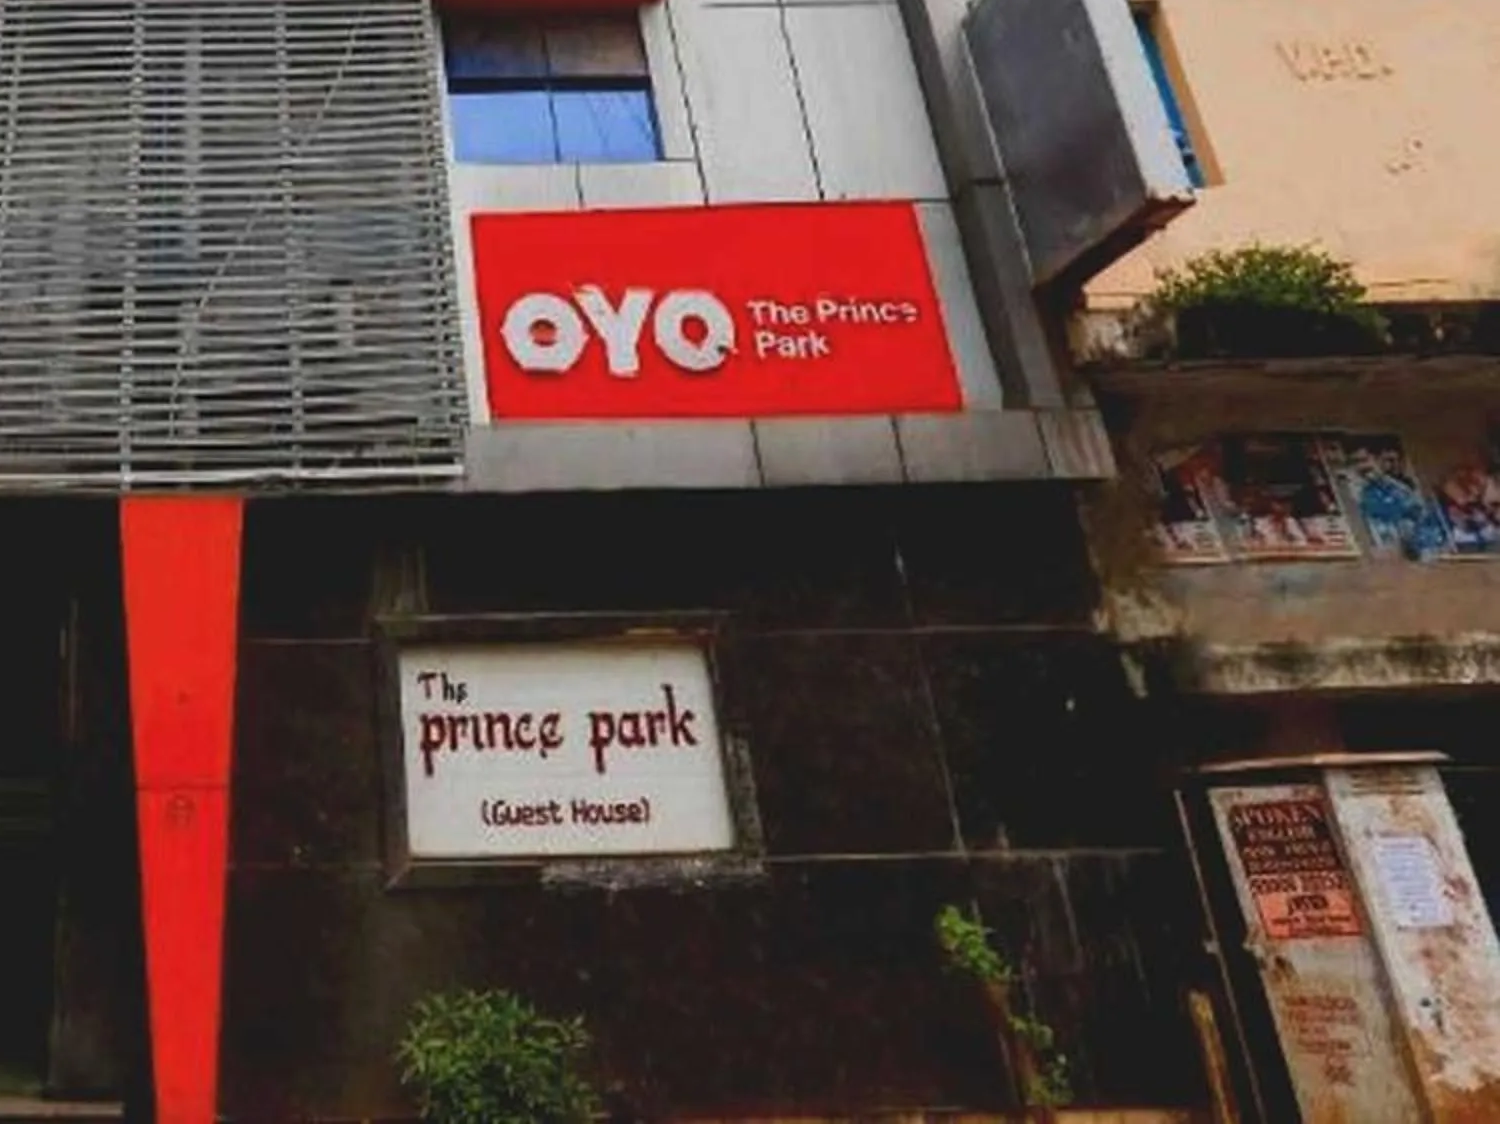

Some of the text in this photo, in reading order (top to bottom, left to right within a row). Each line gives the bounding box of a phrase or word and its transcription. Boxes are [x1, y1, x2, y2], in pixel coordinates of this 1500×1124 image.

[500, 284, 736, 378] OYO
[748, 297, 918, 325] The Prince
[754, 330, 830, 358] Park
[419, 683, 698, 777] prince park
